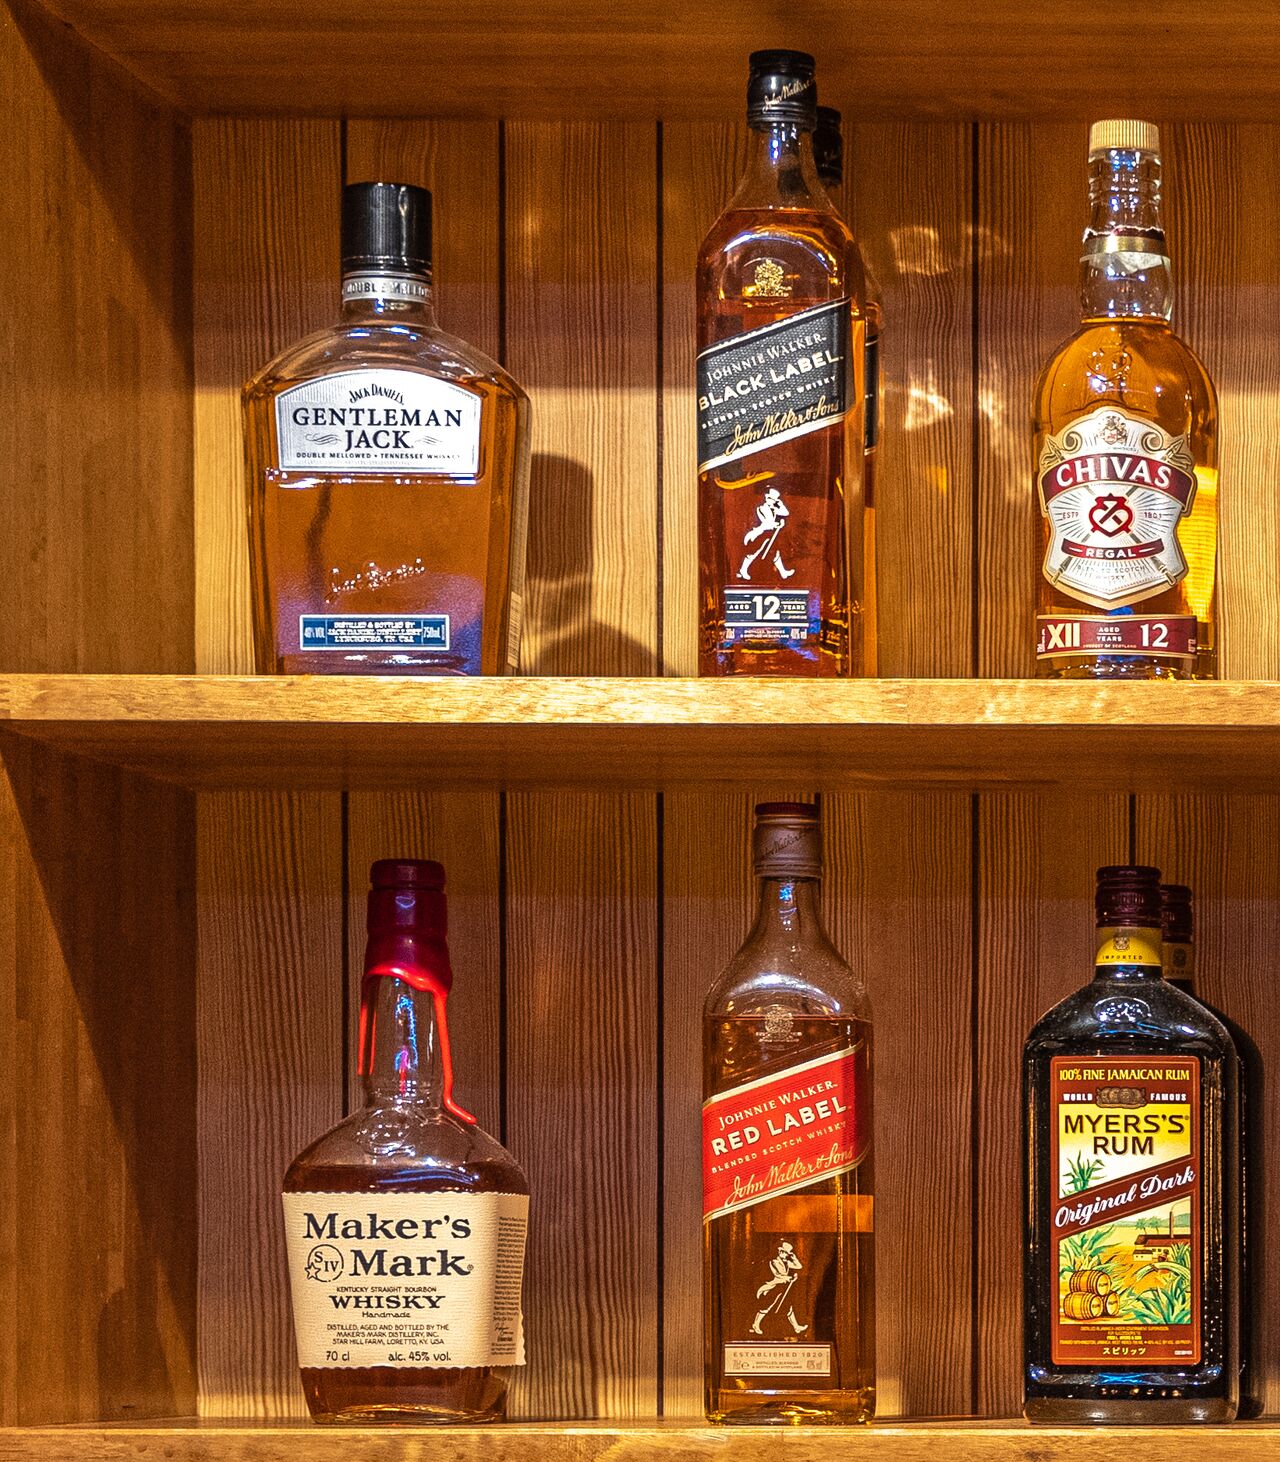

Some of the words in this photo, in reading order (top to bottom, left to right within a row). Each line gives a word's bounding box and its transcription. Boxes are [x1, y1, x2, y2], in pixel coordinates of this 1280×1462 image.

[706, 353, 766, 384] JOHNNIE
[699, 374, 767, 411] BLACK
[292, 408, 462, 427] GENTLEMAN
[345, 430, 412, 452] JACK
[1056, 456, 1172, 488] CHIVAS
[1085, 547, 1136, 559] REGAL
[752, 595, 780, 620] 12
[1047, 623, 1080, 650] XII
[1140, 624, 1169, 648] 12
[1059, 1068, 1082, 1081] 100%
[1083, 1069, 1105, 1081] FINE
[1107, 1069, 1163, 1080] JAMAICAN
[1165, 1069, 1190, 1080] RUM
[719, 1100, 777, 1131] JOHNNIE
[778, 1080, 834, 1106] WALKER
[1063, 1093, 1093, 1101] WORLD
[1150, 1093, 1187, 1101] FAMOUS
[711, 1126, 761, 1156] RED
[766, 1096, 847, 1137] LABEL
[1064, 1114, 1185, 1134] MYERS'S
[1093, 1136, 1154, 1156] RUM
[1054, 1184, 1136, 1229] Original
[1139, 1165, 1196, 1199] Dark
[302, 1212, 471, 1240] Maker's
[349, 1249, 470, 1277] Mark
[329, 1295, 446, 1309] WHISKY
[1102, 1346, 1146, 1356] スピリッツ
